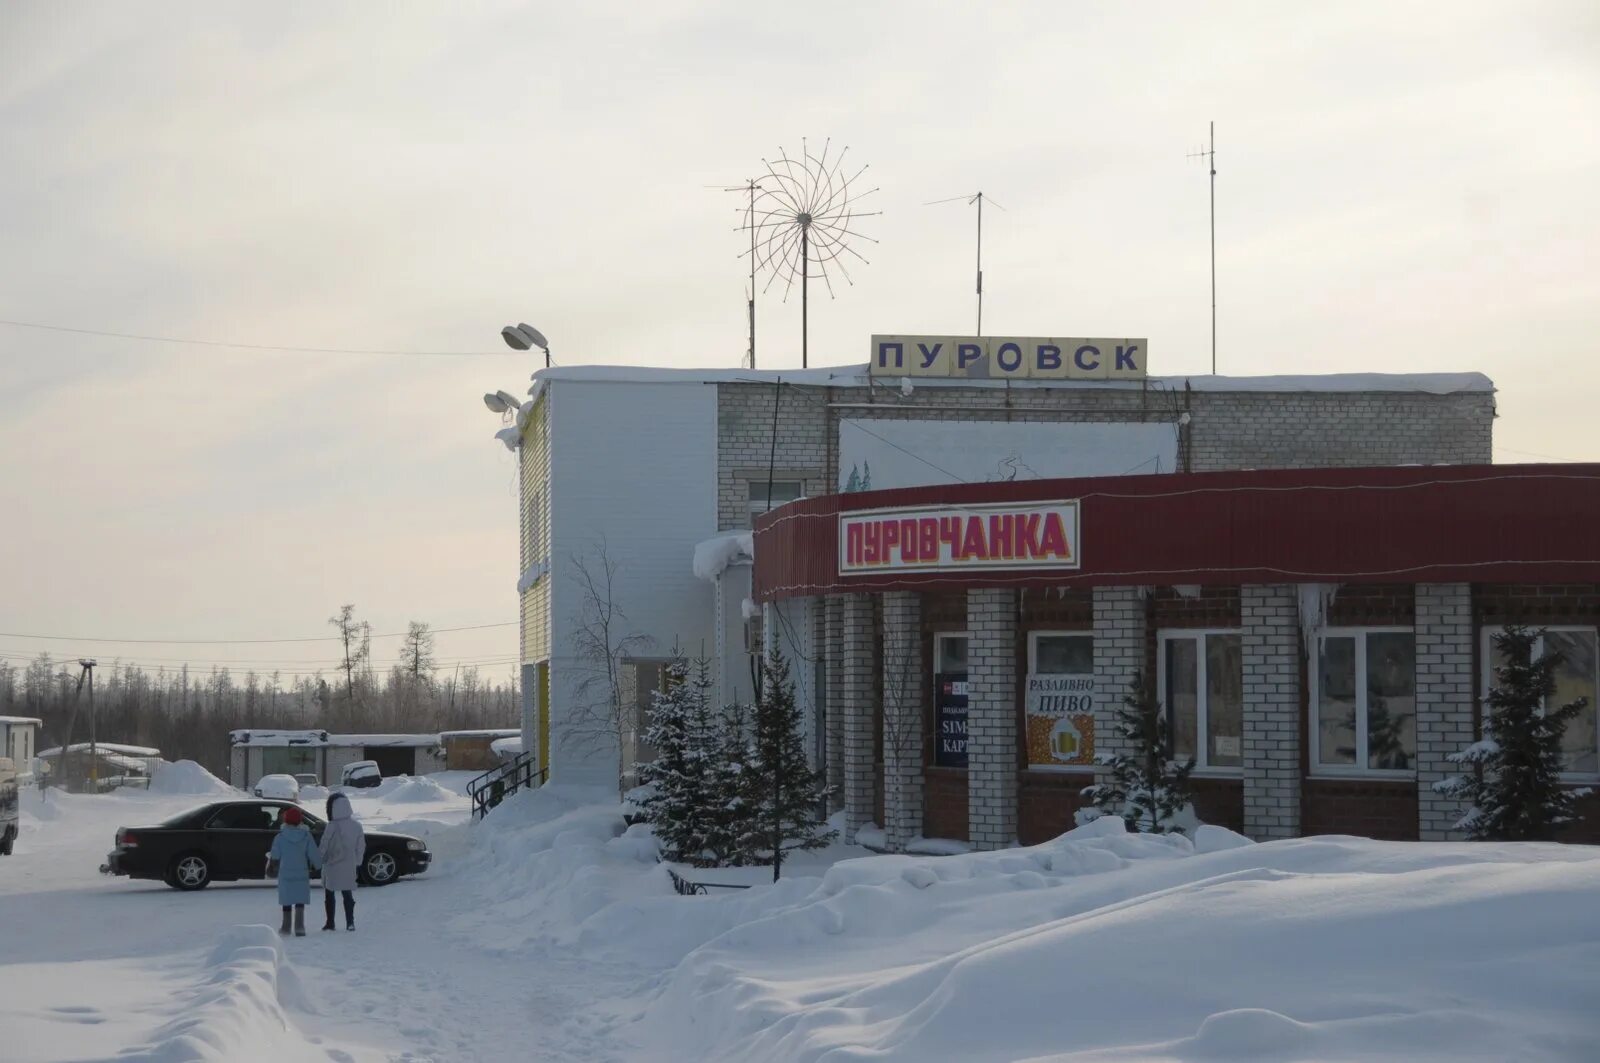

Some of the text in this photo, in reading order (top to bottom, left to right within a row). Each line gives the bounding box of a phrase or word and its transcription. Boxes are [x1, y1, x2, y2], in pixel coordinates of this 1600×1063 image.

[878, 342, 1139, 372] ПУРОВСК
[846, 512, 1071, 567] ПУРОВЧАНКА
[1038, 694, 1093, 712] ПИВО
